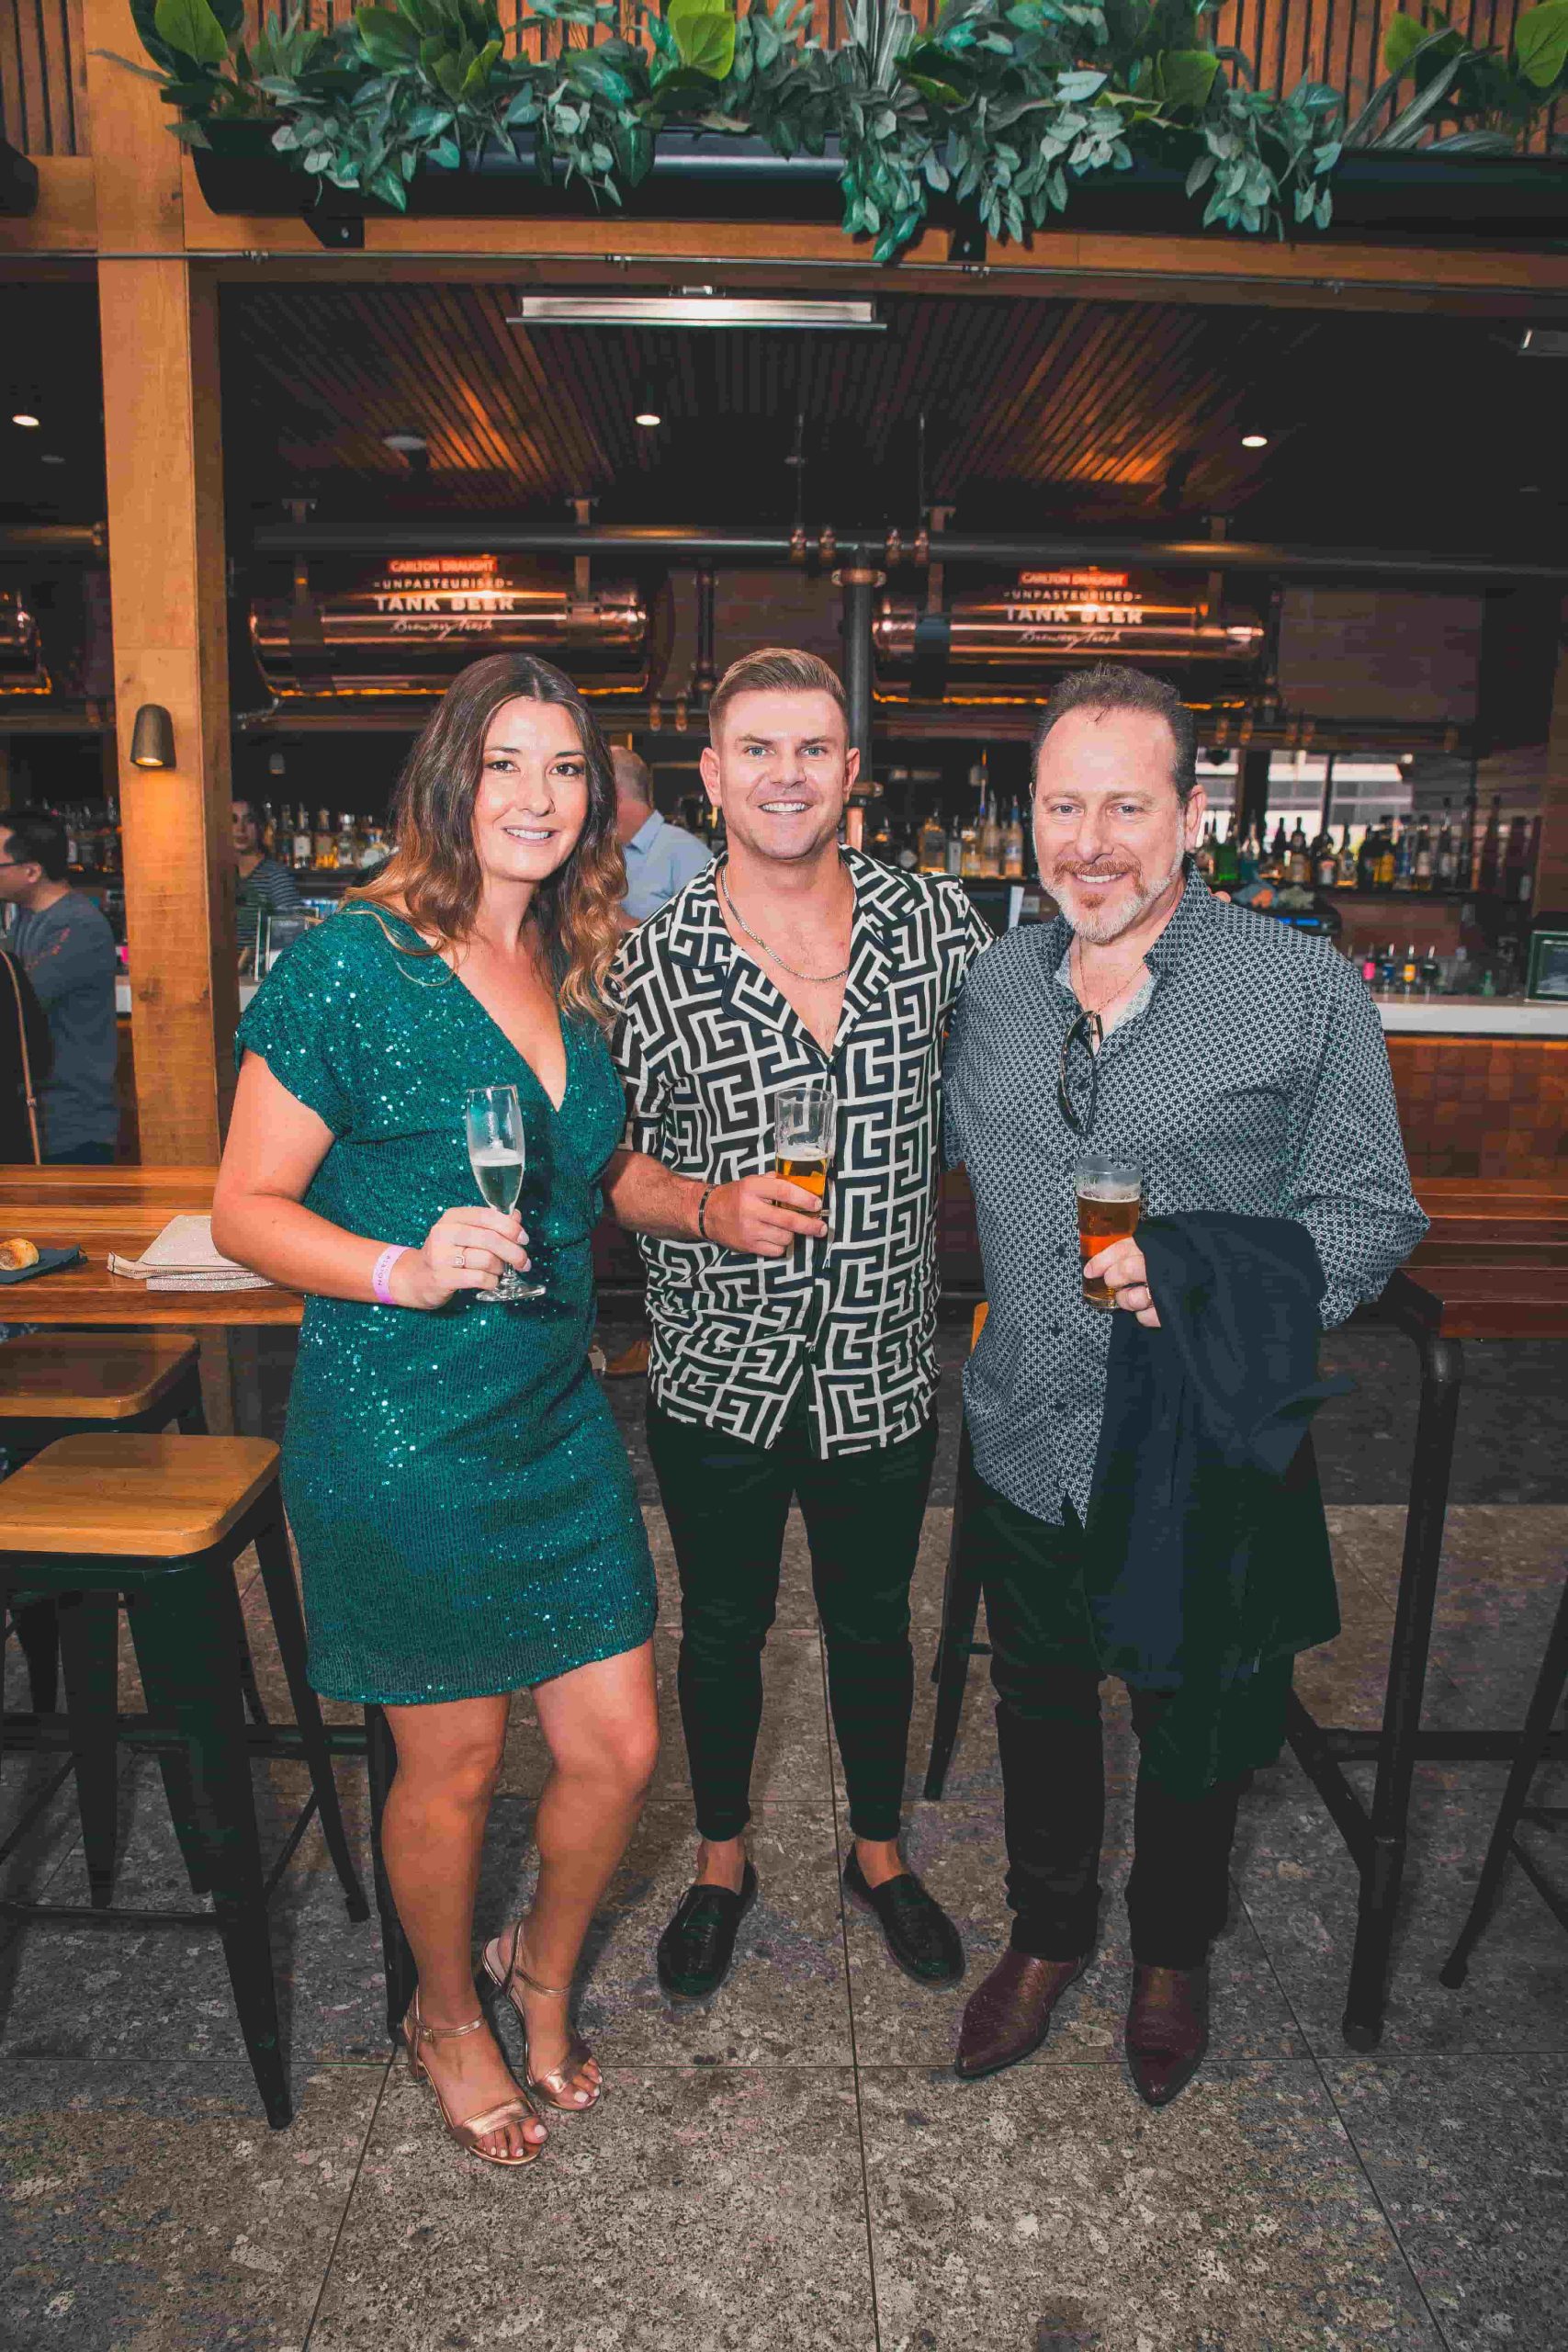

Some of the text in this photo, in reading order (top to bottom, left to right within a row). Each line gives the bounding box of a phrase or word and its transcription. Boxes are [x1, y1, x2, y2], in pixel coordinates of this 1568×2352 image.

[373, 594, 514, 612] TANK BEER
[1003, 605, 1070, 623] TANK
